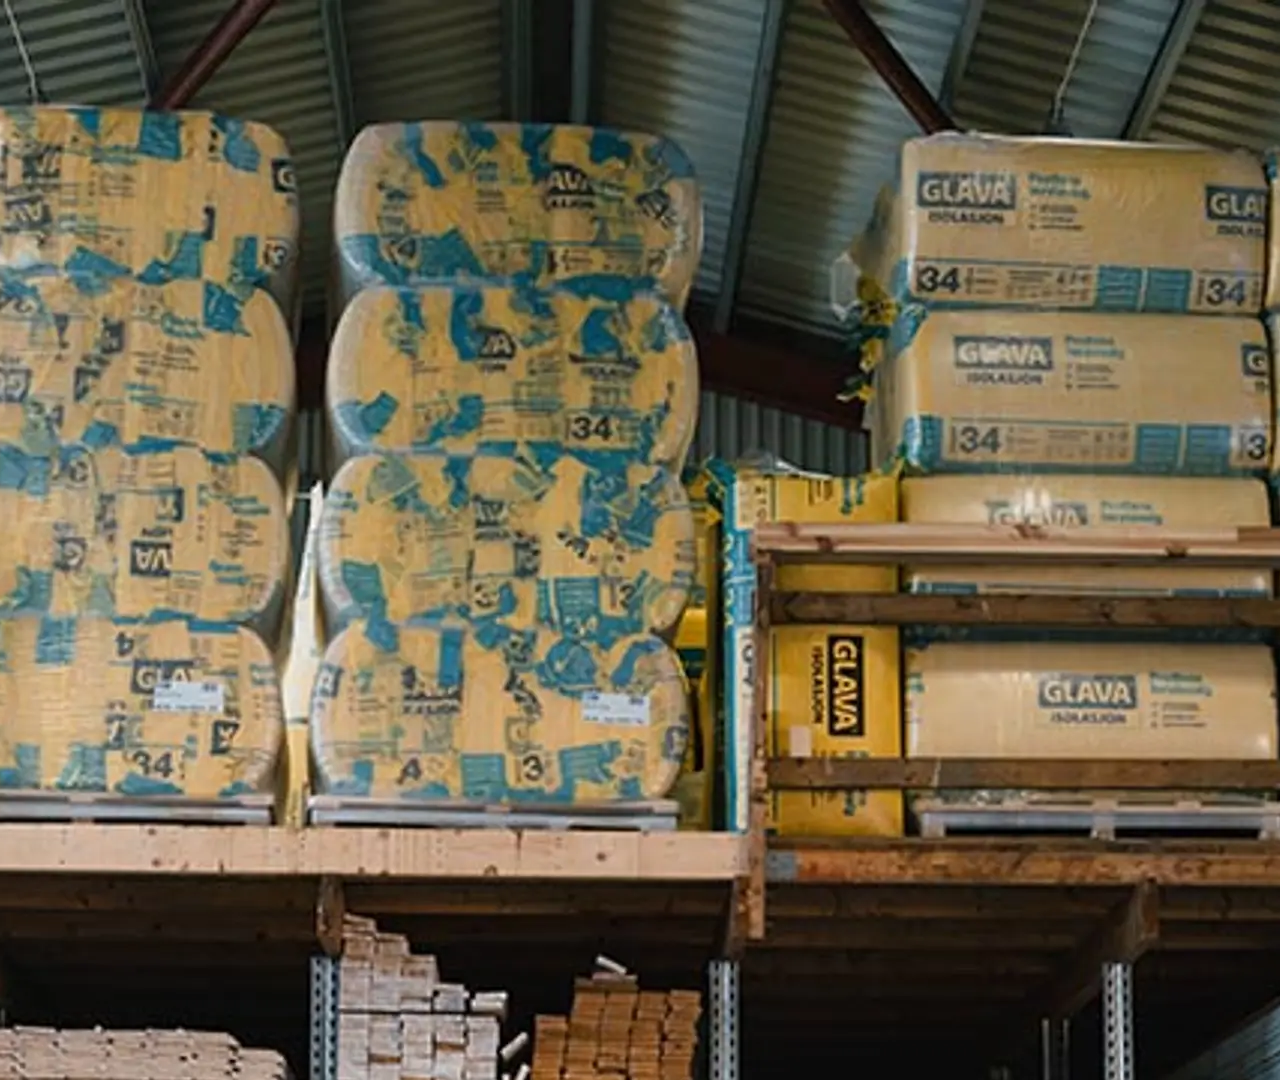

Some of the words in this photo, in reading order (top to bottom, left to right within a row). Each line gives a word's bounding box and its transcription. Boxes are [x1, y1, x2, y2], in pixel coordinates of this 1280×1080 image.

[922, 179, 1012, 205] GLAVA
[1210, 193, 1266, 217] GLA
[916, 266, 961, 293] 34
[1206, 278, 1246, 306] 34
[958, 341, 1049, 366] GLAVA
[572, 416, 613, 441] 34
[959, 426, 1002, 454] 34
[832, 639, 858, 732] GLAVA
[1045, 680, 1133, 704] GLAVA
